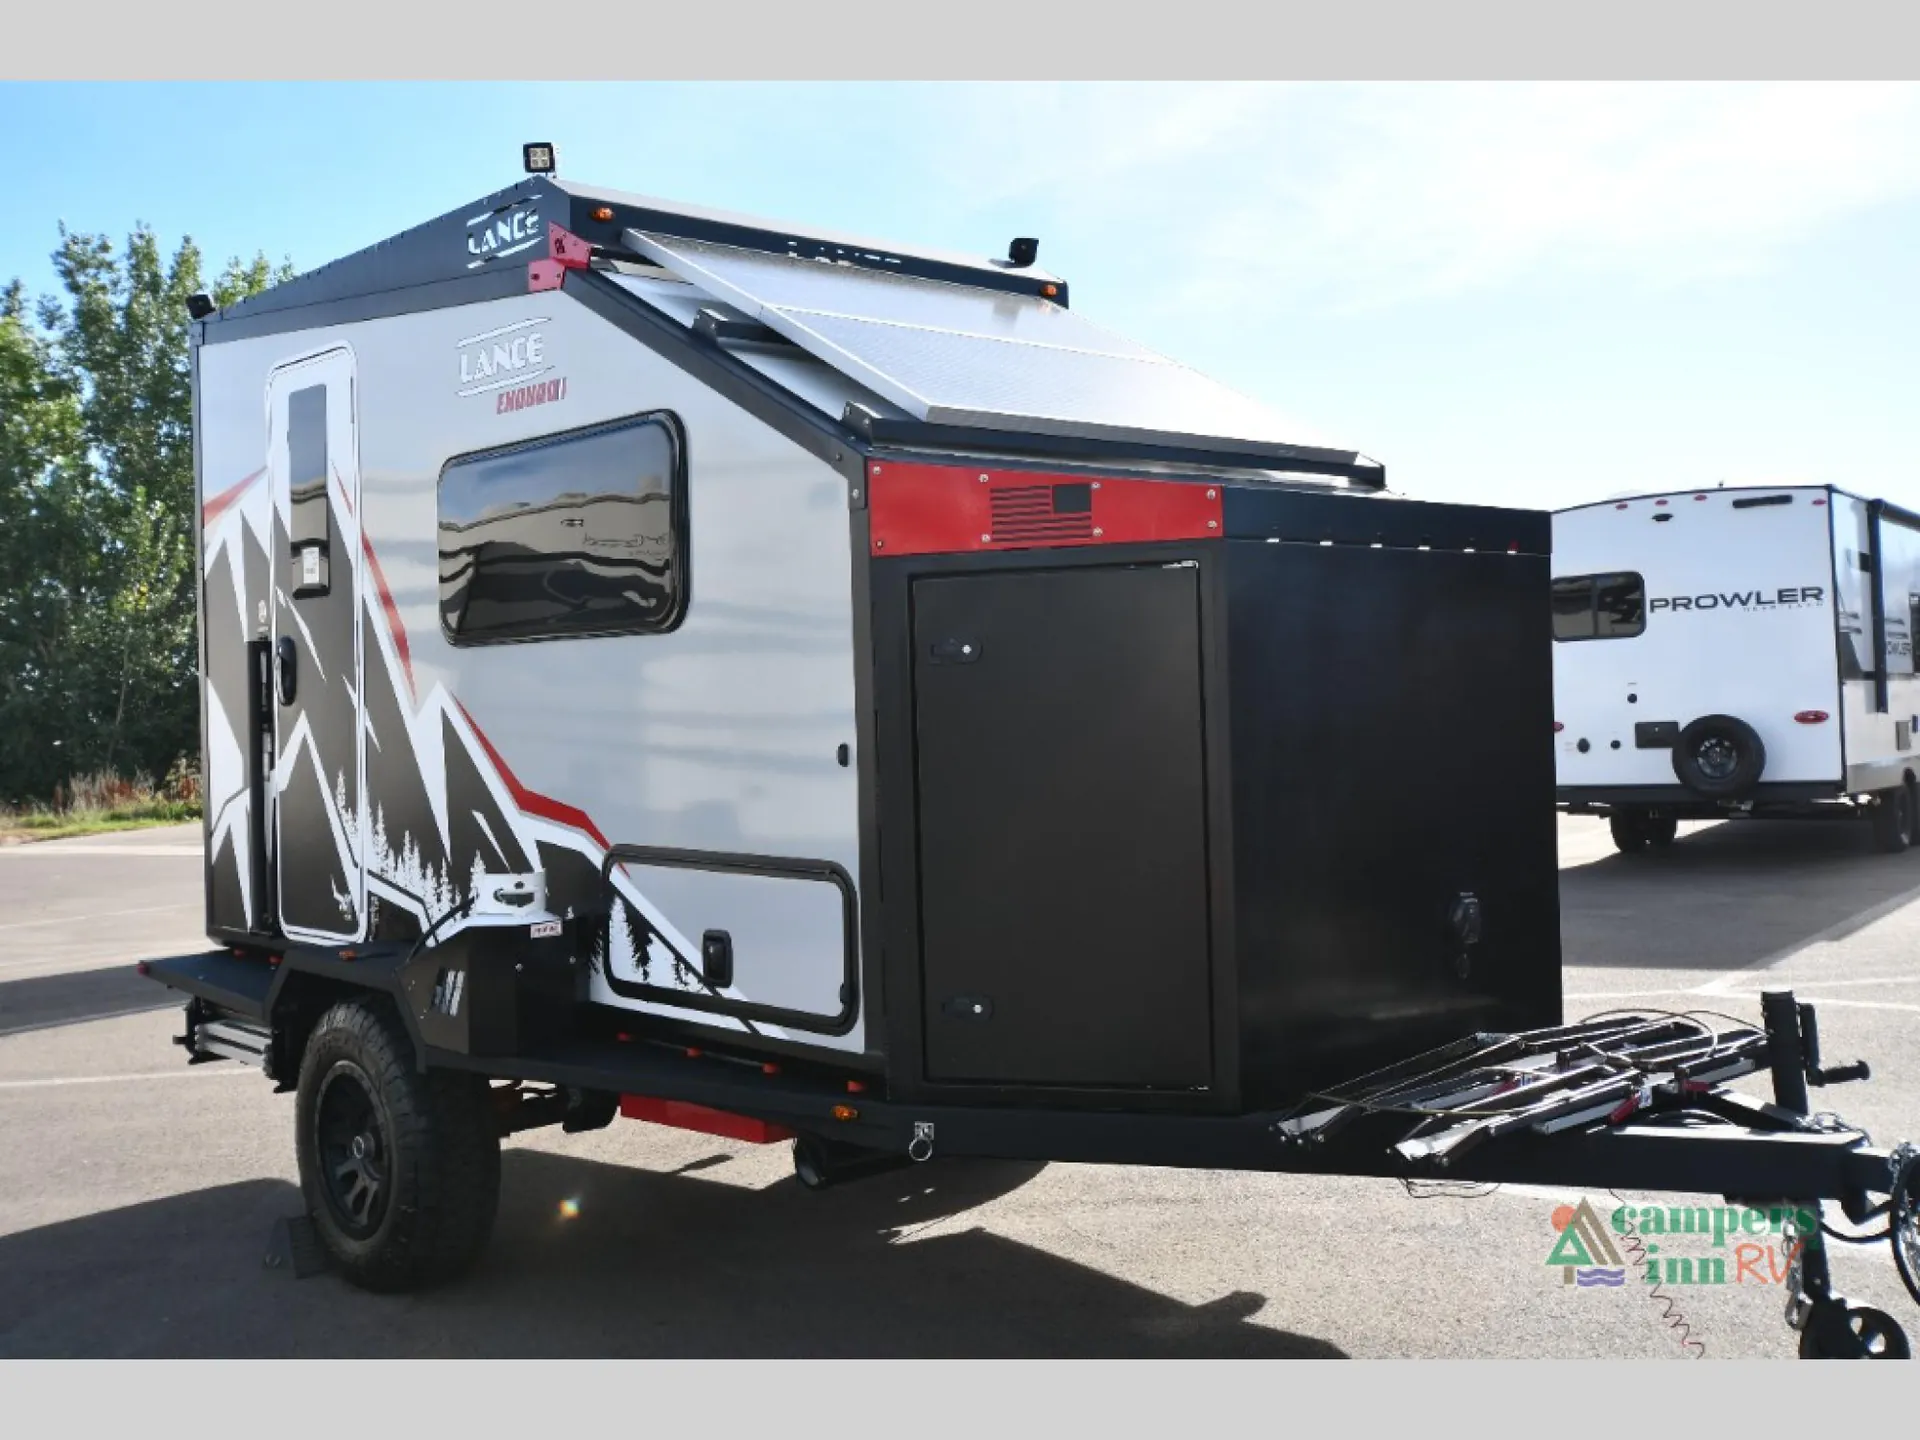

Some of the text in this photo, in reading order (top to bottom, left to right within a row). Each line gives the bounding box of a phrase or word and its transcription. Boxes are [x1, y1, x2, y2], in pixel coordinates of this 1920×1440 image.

[467, 210, 539, 255] LANCE
[461, 332, 544, 384] LANCE
[1650, 586, 1824, 613] PROWLER
